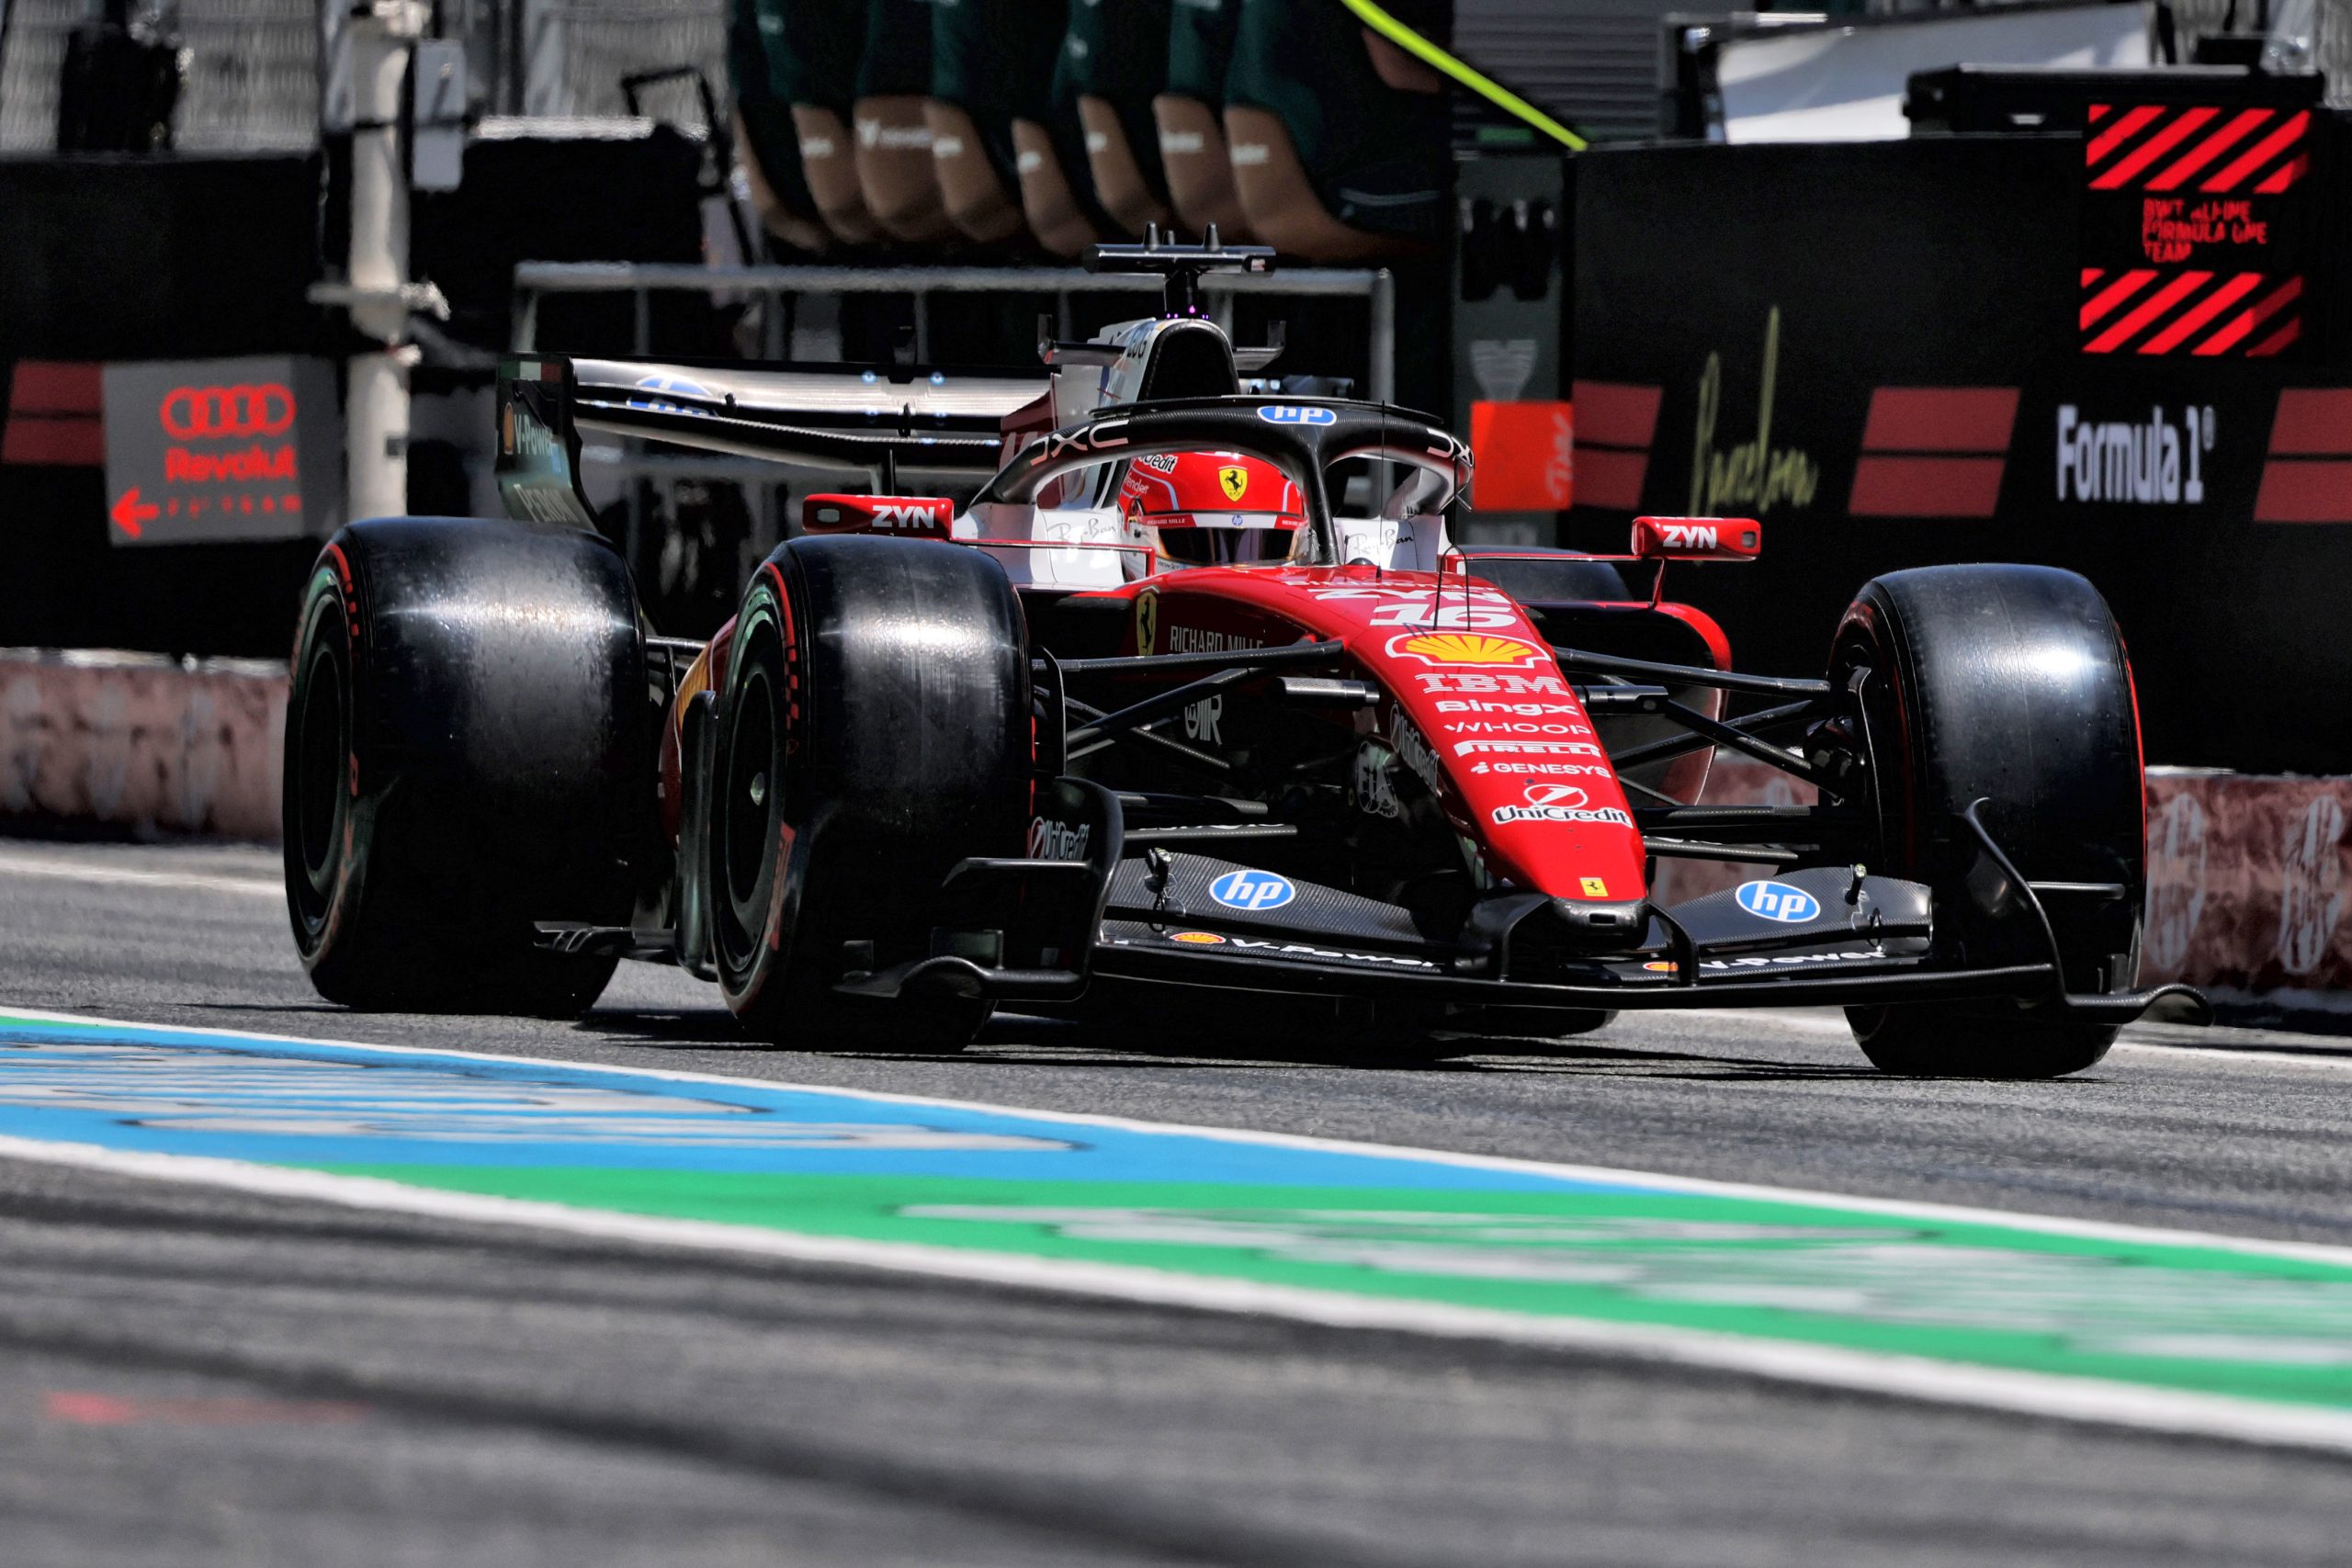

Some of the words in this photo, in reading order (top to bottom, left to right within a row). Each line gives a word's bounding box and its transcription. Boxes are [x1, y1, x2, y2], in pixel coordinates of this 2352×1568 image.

[2057, 404, 2180, 503] Formula
[871, 504, 935, 529] ZYN
[1662, 525, 1717, 548] ZYN
[1307, 588, 1512, 605] ZYN
[1369, 603, 1517, 627] 16
[1170, 625, 1224, 653] RICHARD
[1415, 673, 1570, 697] IBM
[1443, 721, 1592, 735] WHOOP
[1454, 740, 1602, 758] PIRELLI
[1493, 762, 1611, 779] GENESYS
[1494, 804, 1633, 828] UniCredit
[1223, 870, 1284, 909] hp
[1752, 880, 1807, 920] hp
[1231, 938, 1435, 968] V-Power
[1700, 951, 1886, 970] V-Power
